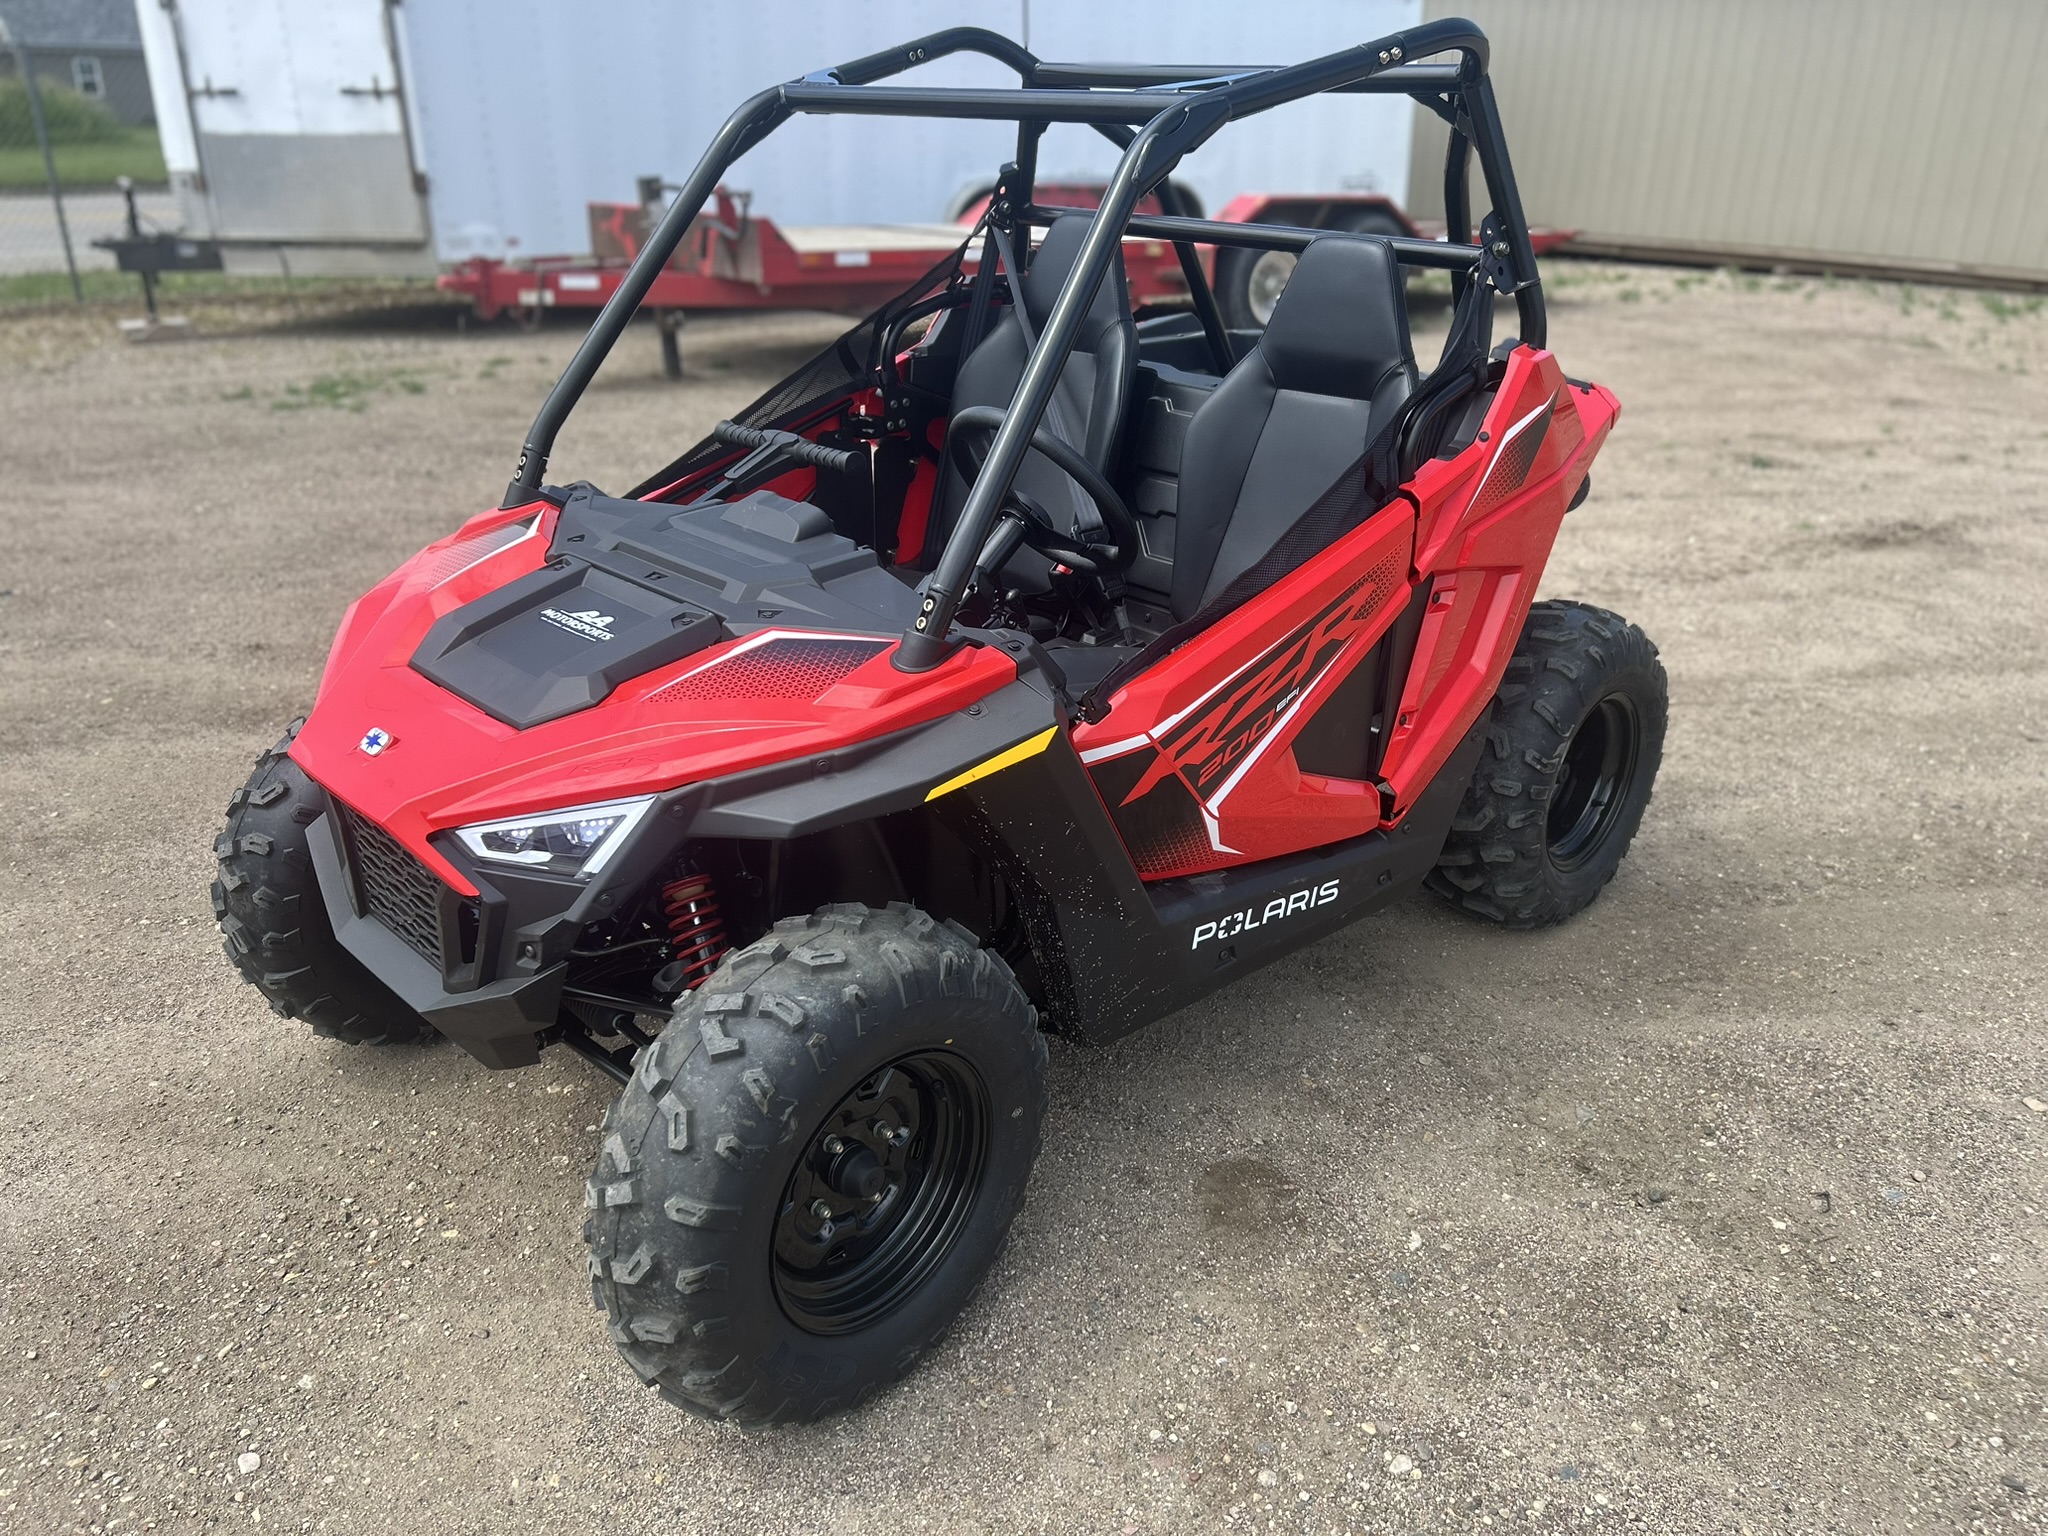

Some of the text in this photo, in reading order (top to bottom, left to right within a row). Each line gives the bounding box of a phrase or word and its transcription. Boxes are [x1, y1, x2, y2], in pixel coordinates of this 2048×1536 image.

[540, 608, 615, 640] MOTORSPORTS
[1119, 583, 1376, 807] RZR
[1198, 686, 1300, 787] 200 EFI
[1191, 878, 1340, 950] POLARIS
